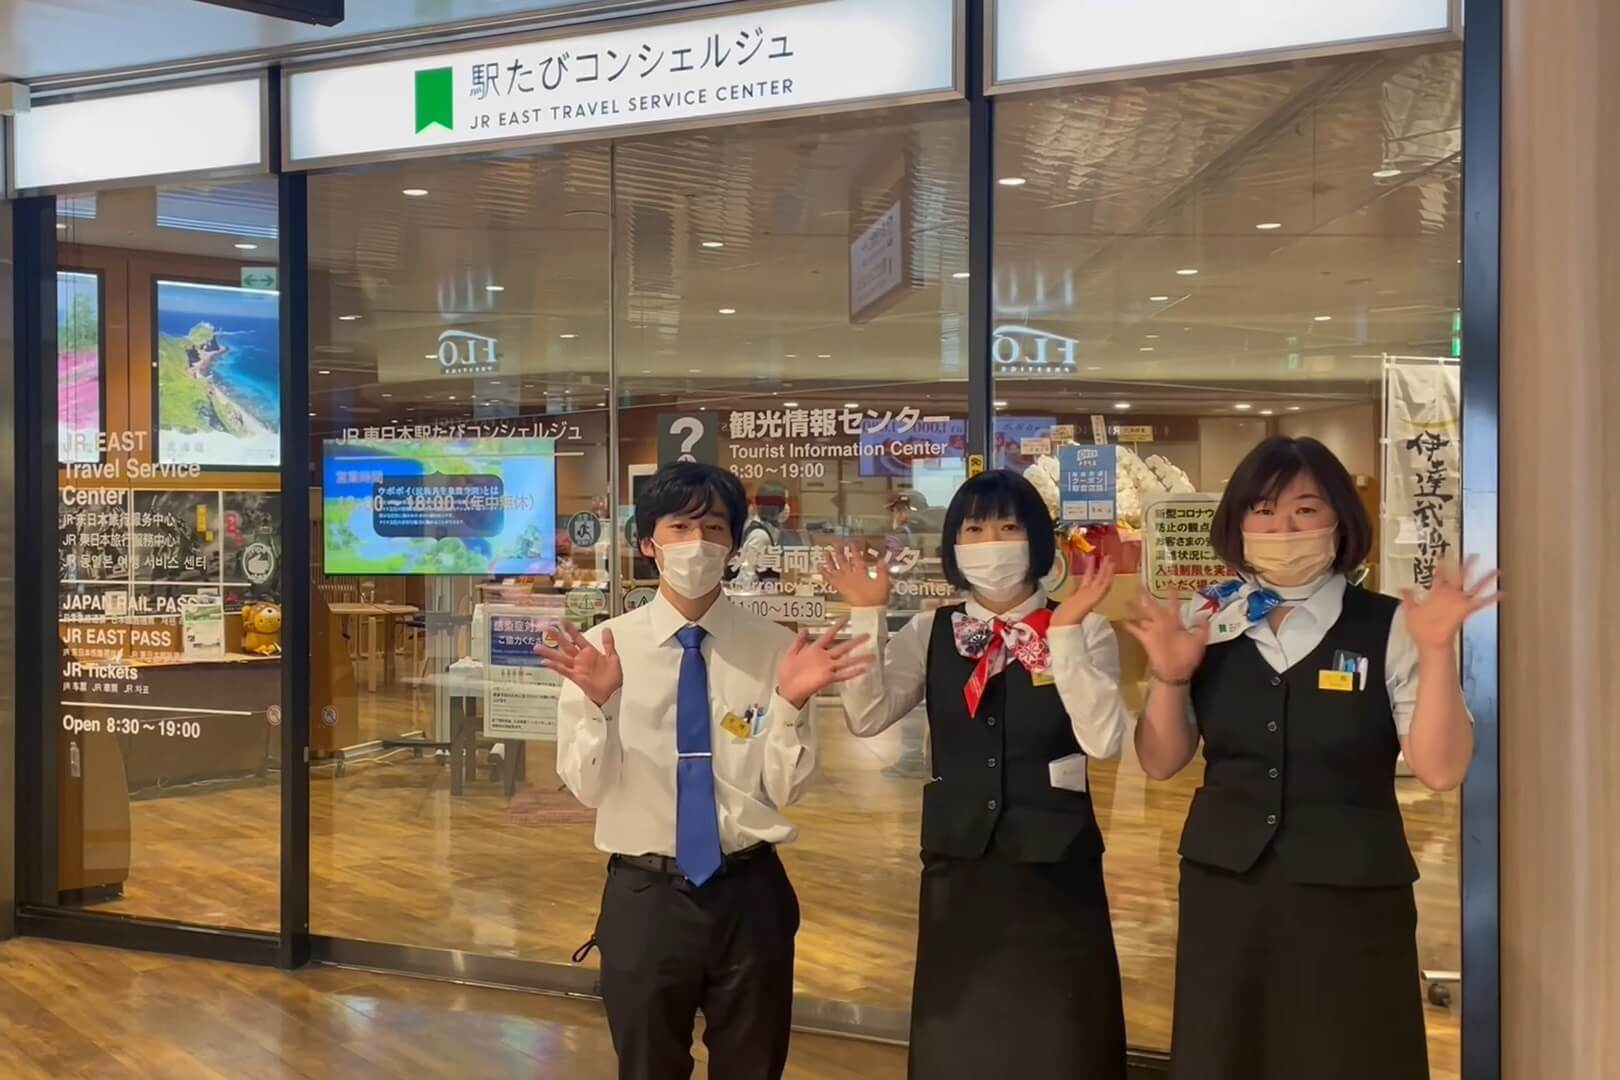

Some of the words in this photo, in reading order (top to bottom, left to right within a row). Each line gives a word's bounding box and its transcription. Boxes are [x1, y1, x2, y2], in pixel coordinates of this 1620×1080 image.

[469, 26, 794, 100] 駅たびコンシェルジュ
[470, 115, 491, 129] JR
[499, 108, 542, 126] EAST
[550, 99, 619, 120] TRAVEL
[628, 89, 707, 111] SERVICE
[715, 78, 794, 101] CENTER
[729, 406, 950, 439] 観光情報センター
[96, 431, 147, 452] EAST
[336, 427, 360, 444] JR
[729, 444, 785, 459] Tourist
[789, 442, 886, 458] Information
[889, 440, 949, 456] Center
[64, 458, 120, 480] Travel
[126, 458, 201, 479] Service
[62, 485, 126, 506] Center
[156, 596, 198, 613] PASS
[63, 628, 82, 643] JR
[86, 629, 127, 645] EAST
[131, 630, 172, 647] PASS
[63, 662, 82, 677] JR
[87, 665, 139, 680] Tickets
[63, 714, 101, 734] Open
